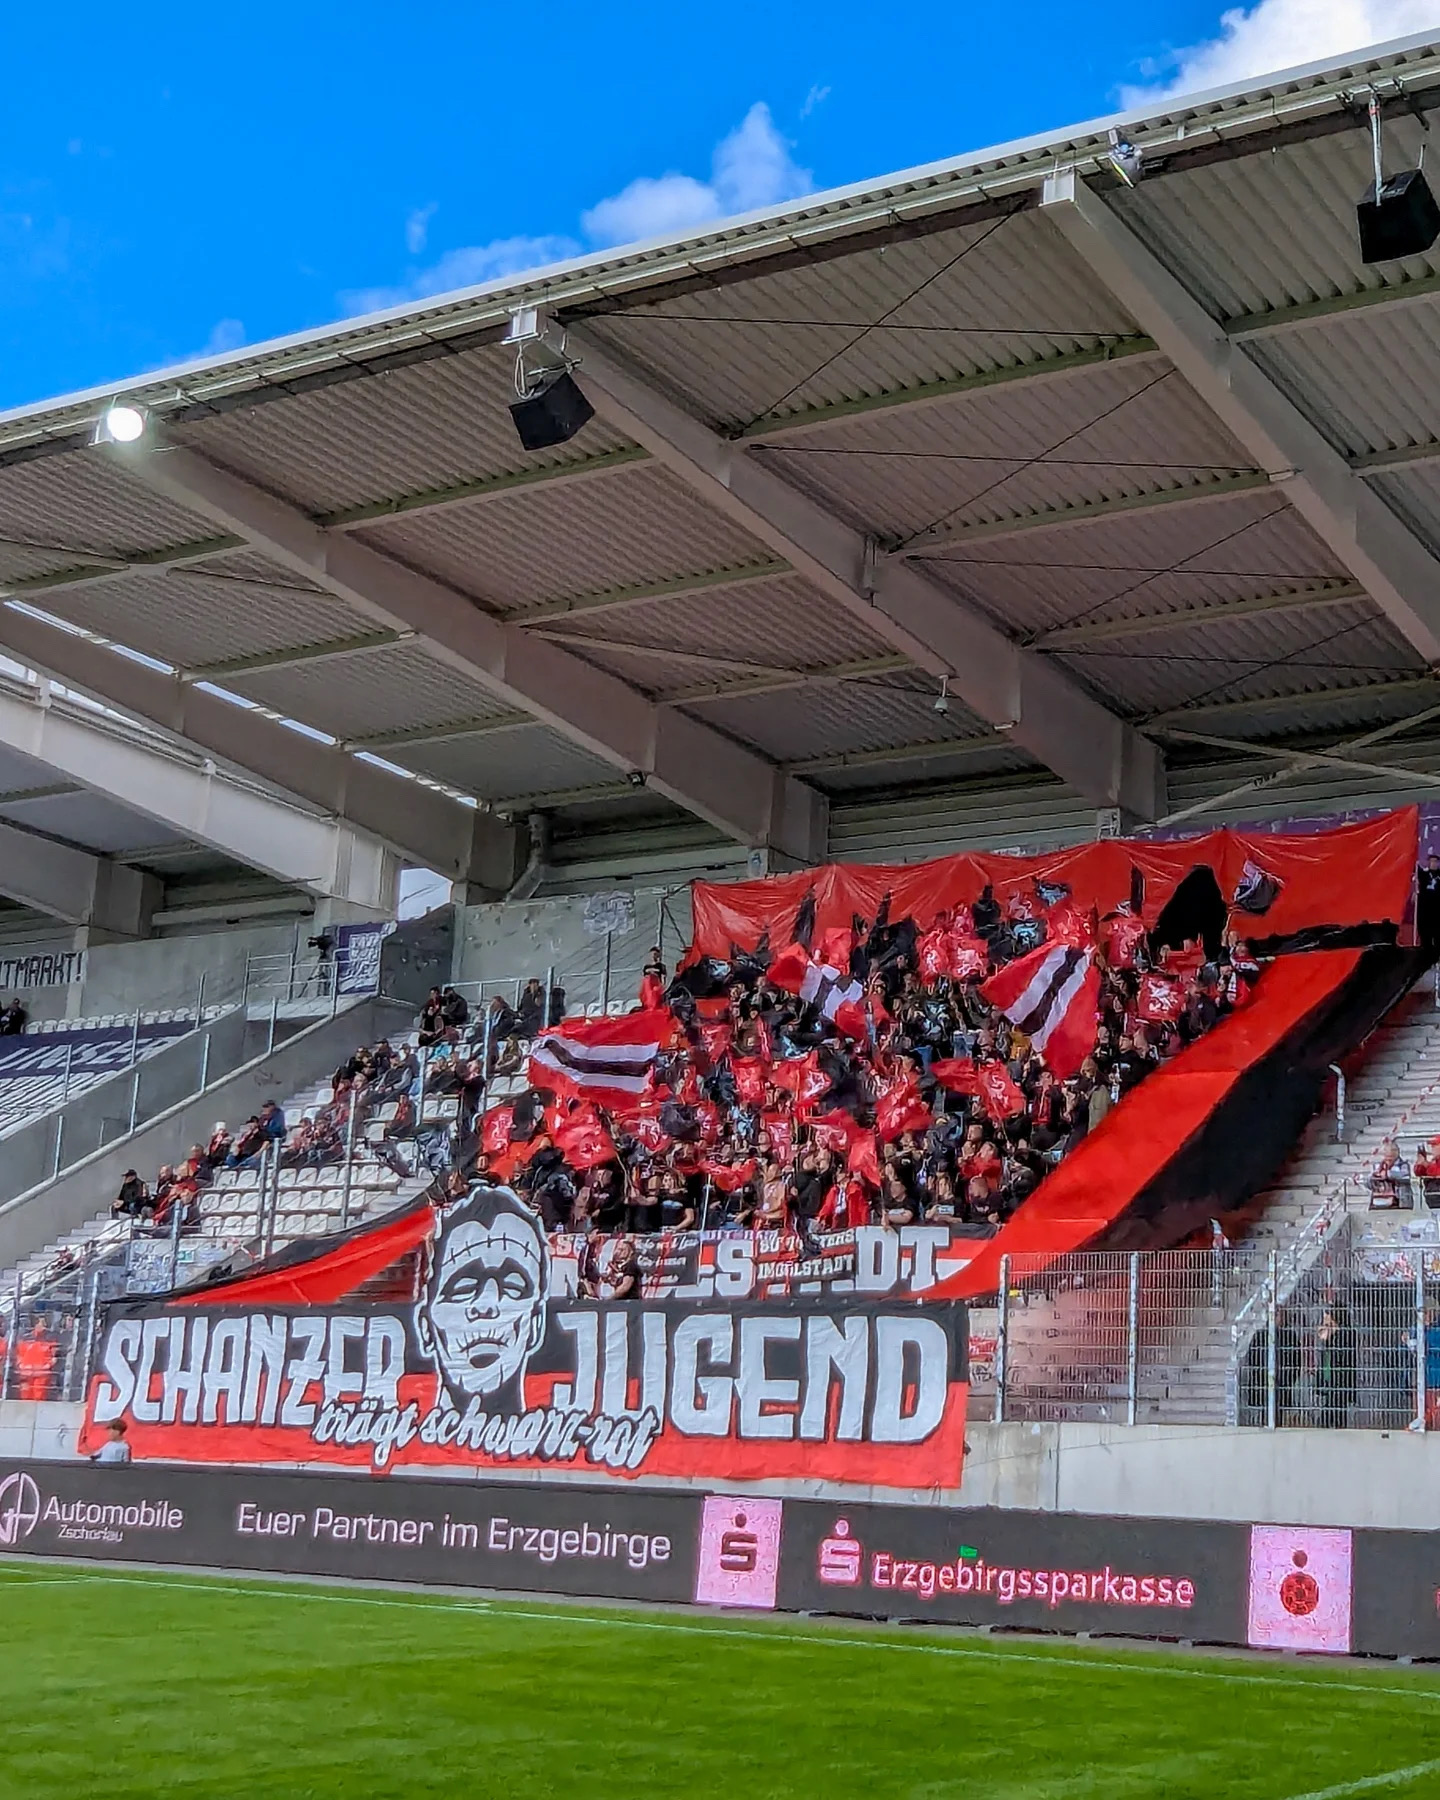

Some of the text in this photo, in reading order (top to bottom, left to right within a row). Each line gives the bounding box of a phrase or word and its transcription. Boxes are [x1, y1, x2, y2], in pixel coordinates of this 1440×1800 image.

[94, 1311, 948, 1442] SCHANZER JUGEND
[313, 1401, 418, 1467] trägt
[44, 1496, 183, 1528] Automobile
[238, 1503, 671, 1568] Euer Partner im Erzgebirge
[874, 1553, 1194, 1607] Erzgebirgssparkasse
